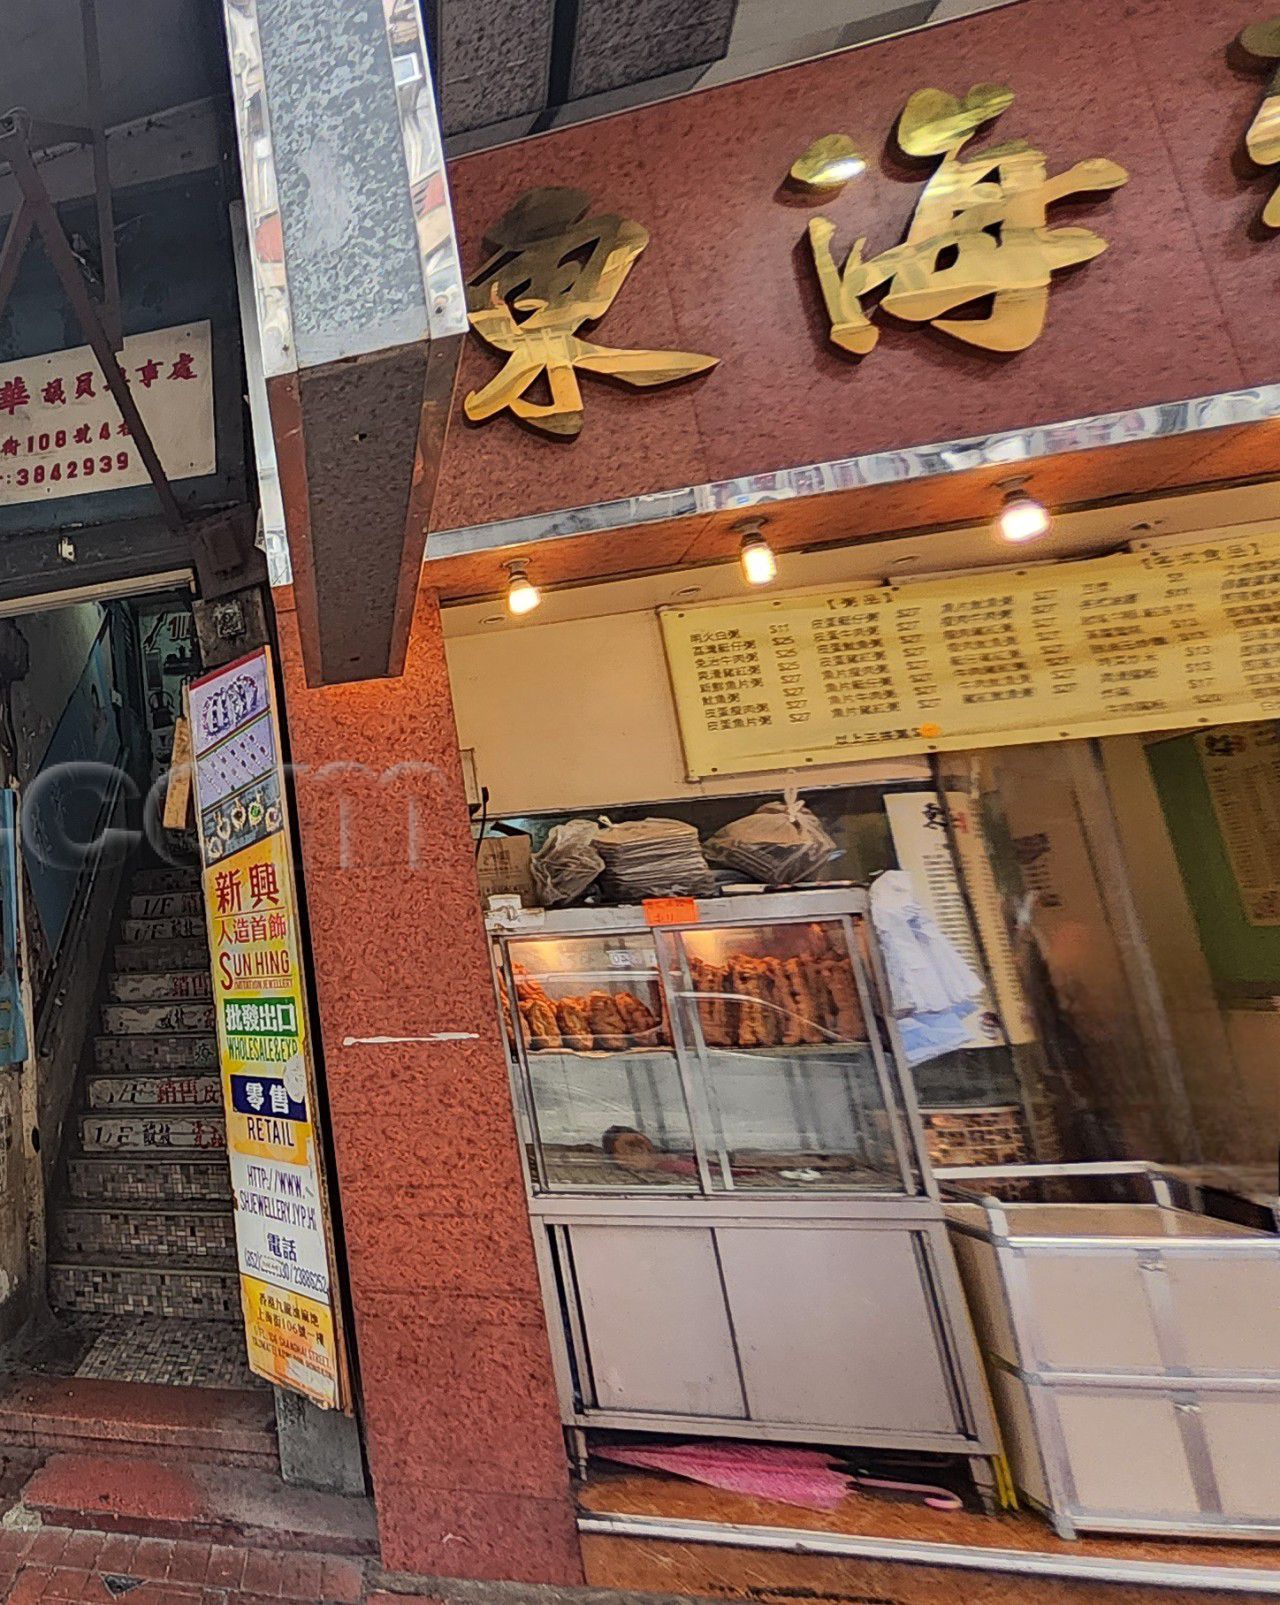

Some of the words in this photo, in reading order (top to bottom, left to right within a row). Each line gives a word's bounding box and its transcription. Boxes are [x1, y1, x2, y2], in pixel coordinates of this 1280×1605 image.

[215, 862, 280, 914] 新興
[217, 913, 287, 947] 人造首飾
[220, 951, 252, 991] SUN
[256, 949, 290, 976] HING
[226, 1003, 296, 1032] 批發出口
[245, 1081, 290, 1114] 零售
[247, 1116, 295, 1147] RETAIL
[266, 1232, 297, 1263] 電話
